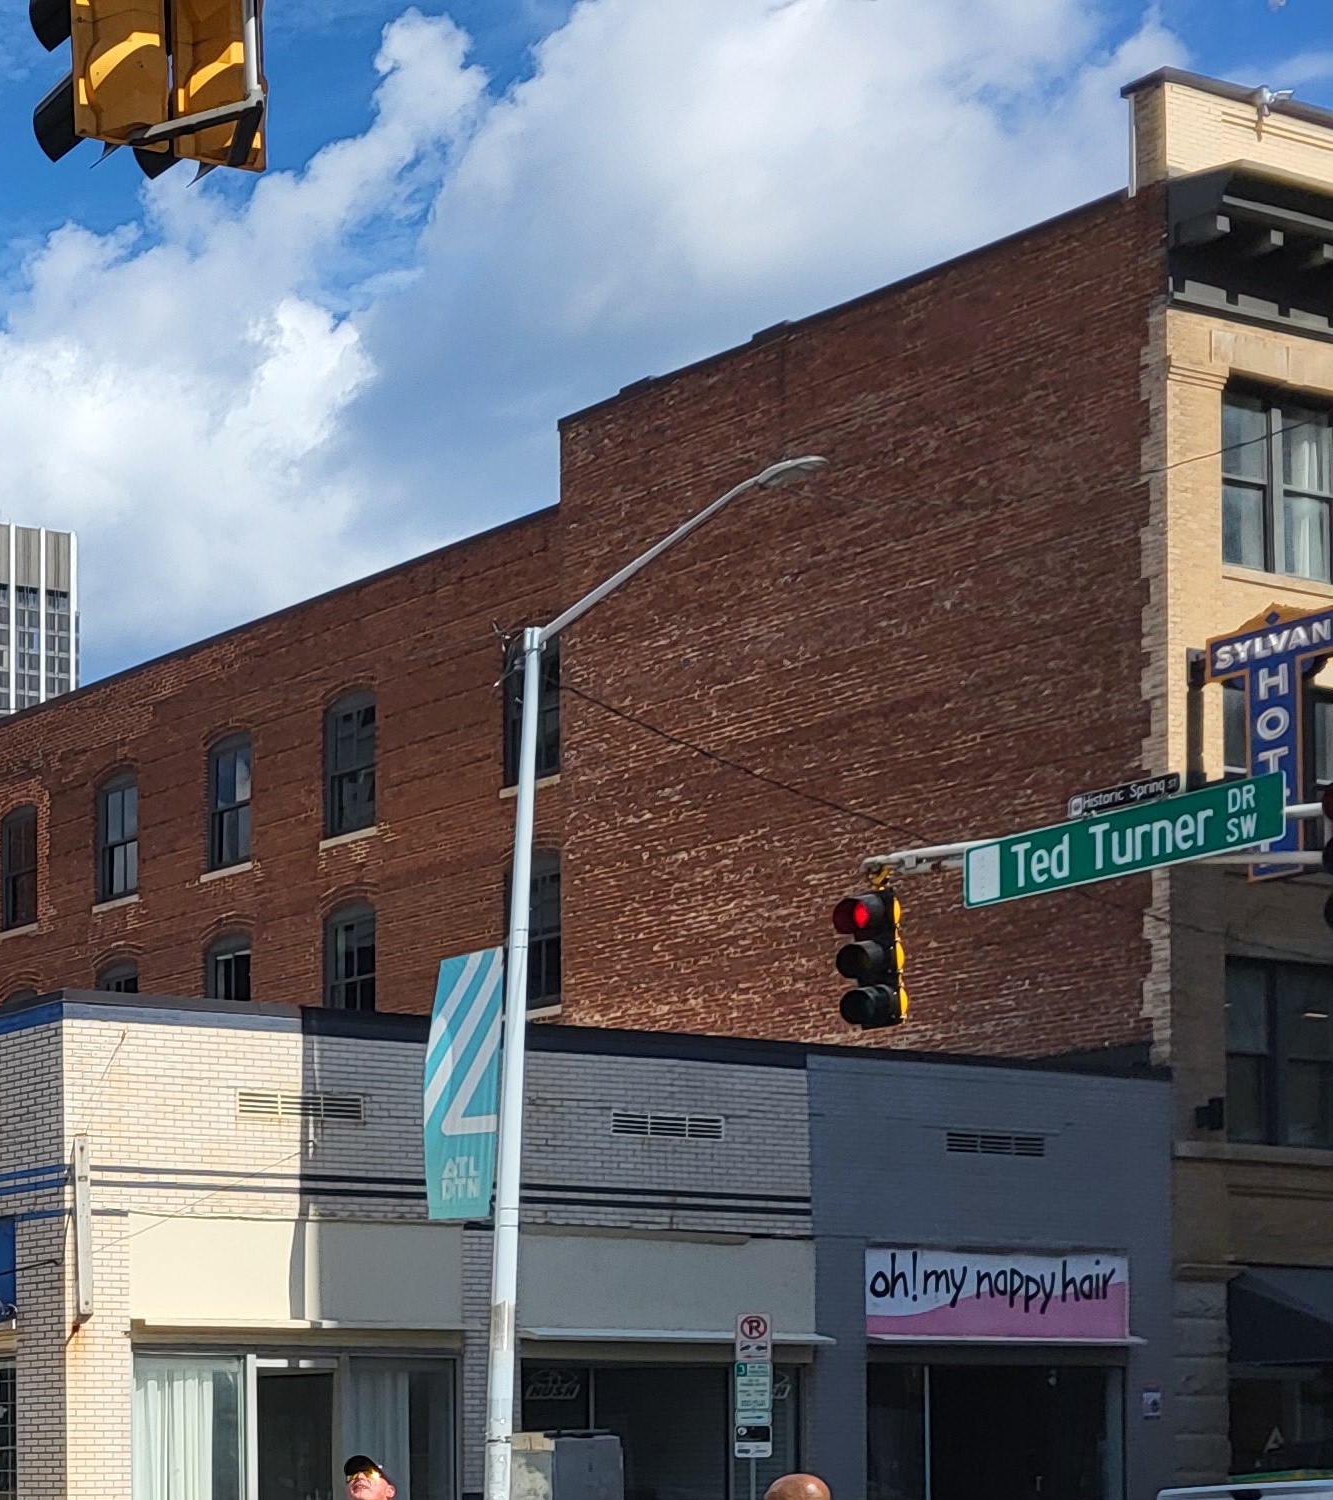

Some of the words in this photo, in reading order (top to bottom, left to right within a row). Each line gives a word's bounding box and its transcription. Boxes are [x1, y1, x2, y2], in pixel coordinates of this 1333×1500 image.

[1215, 619, 1332, 669] SYLVAN
[1083, 789, 1124, 810] Historic
[1129, 779, 1165, 800] Spring
[1228, 784, 1255, 813] DR
[1226, 813, 1257, 843] SW
[1010, 833, 1070, 888] Ted
[1088, 809, 1214, 870] Turner
[441, 1156, 480, 1178] ATL
[441, 1177, 480, 1201] DTN
[923, 1266, 968, 1308] my
[975, 1268, 1056, 1314] nappy
[1061, 1259, 1116, 1303] hair
